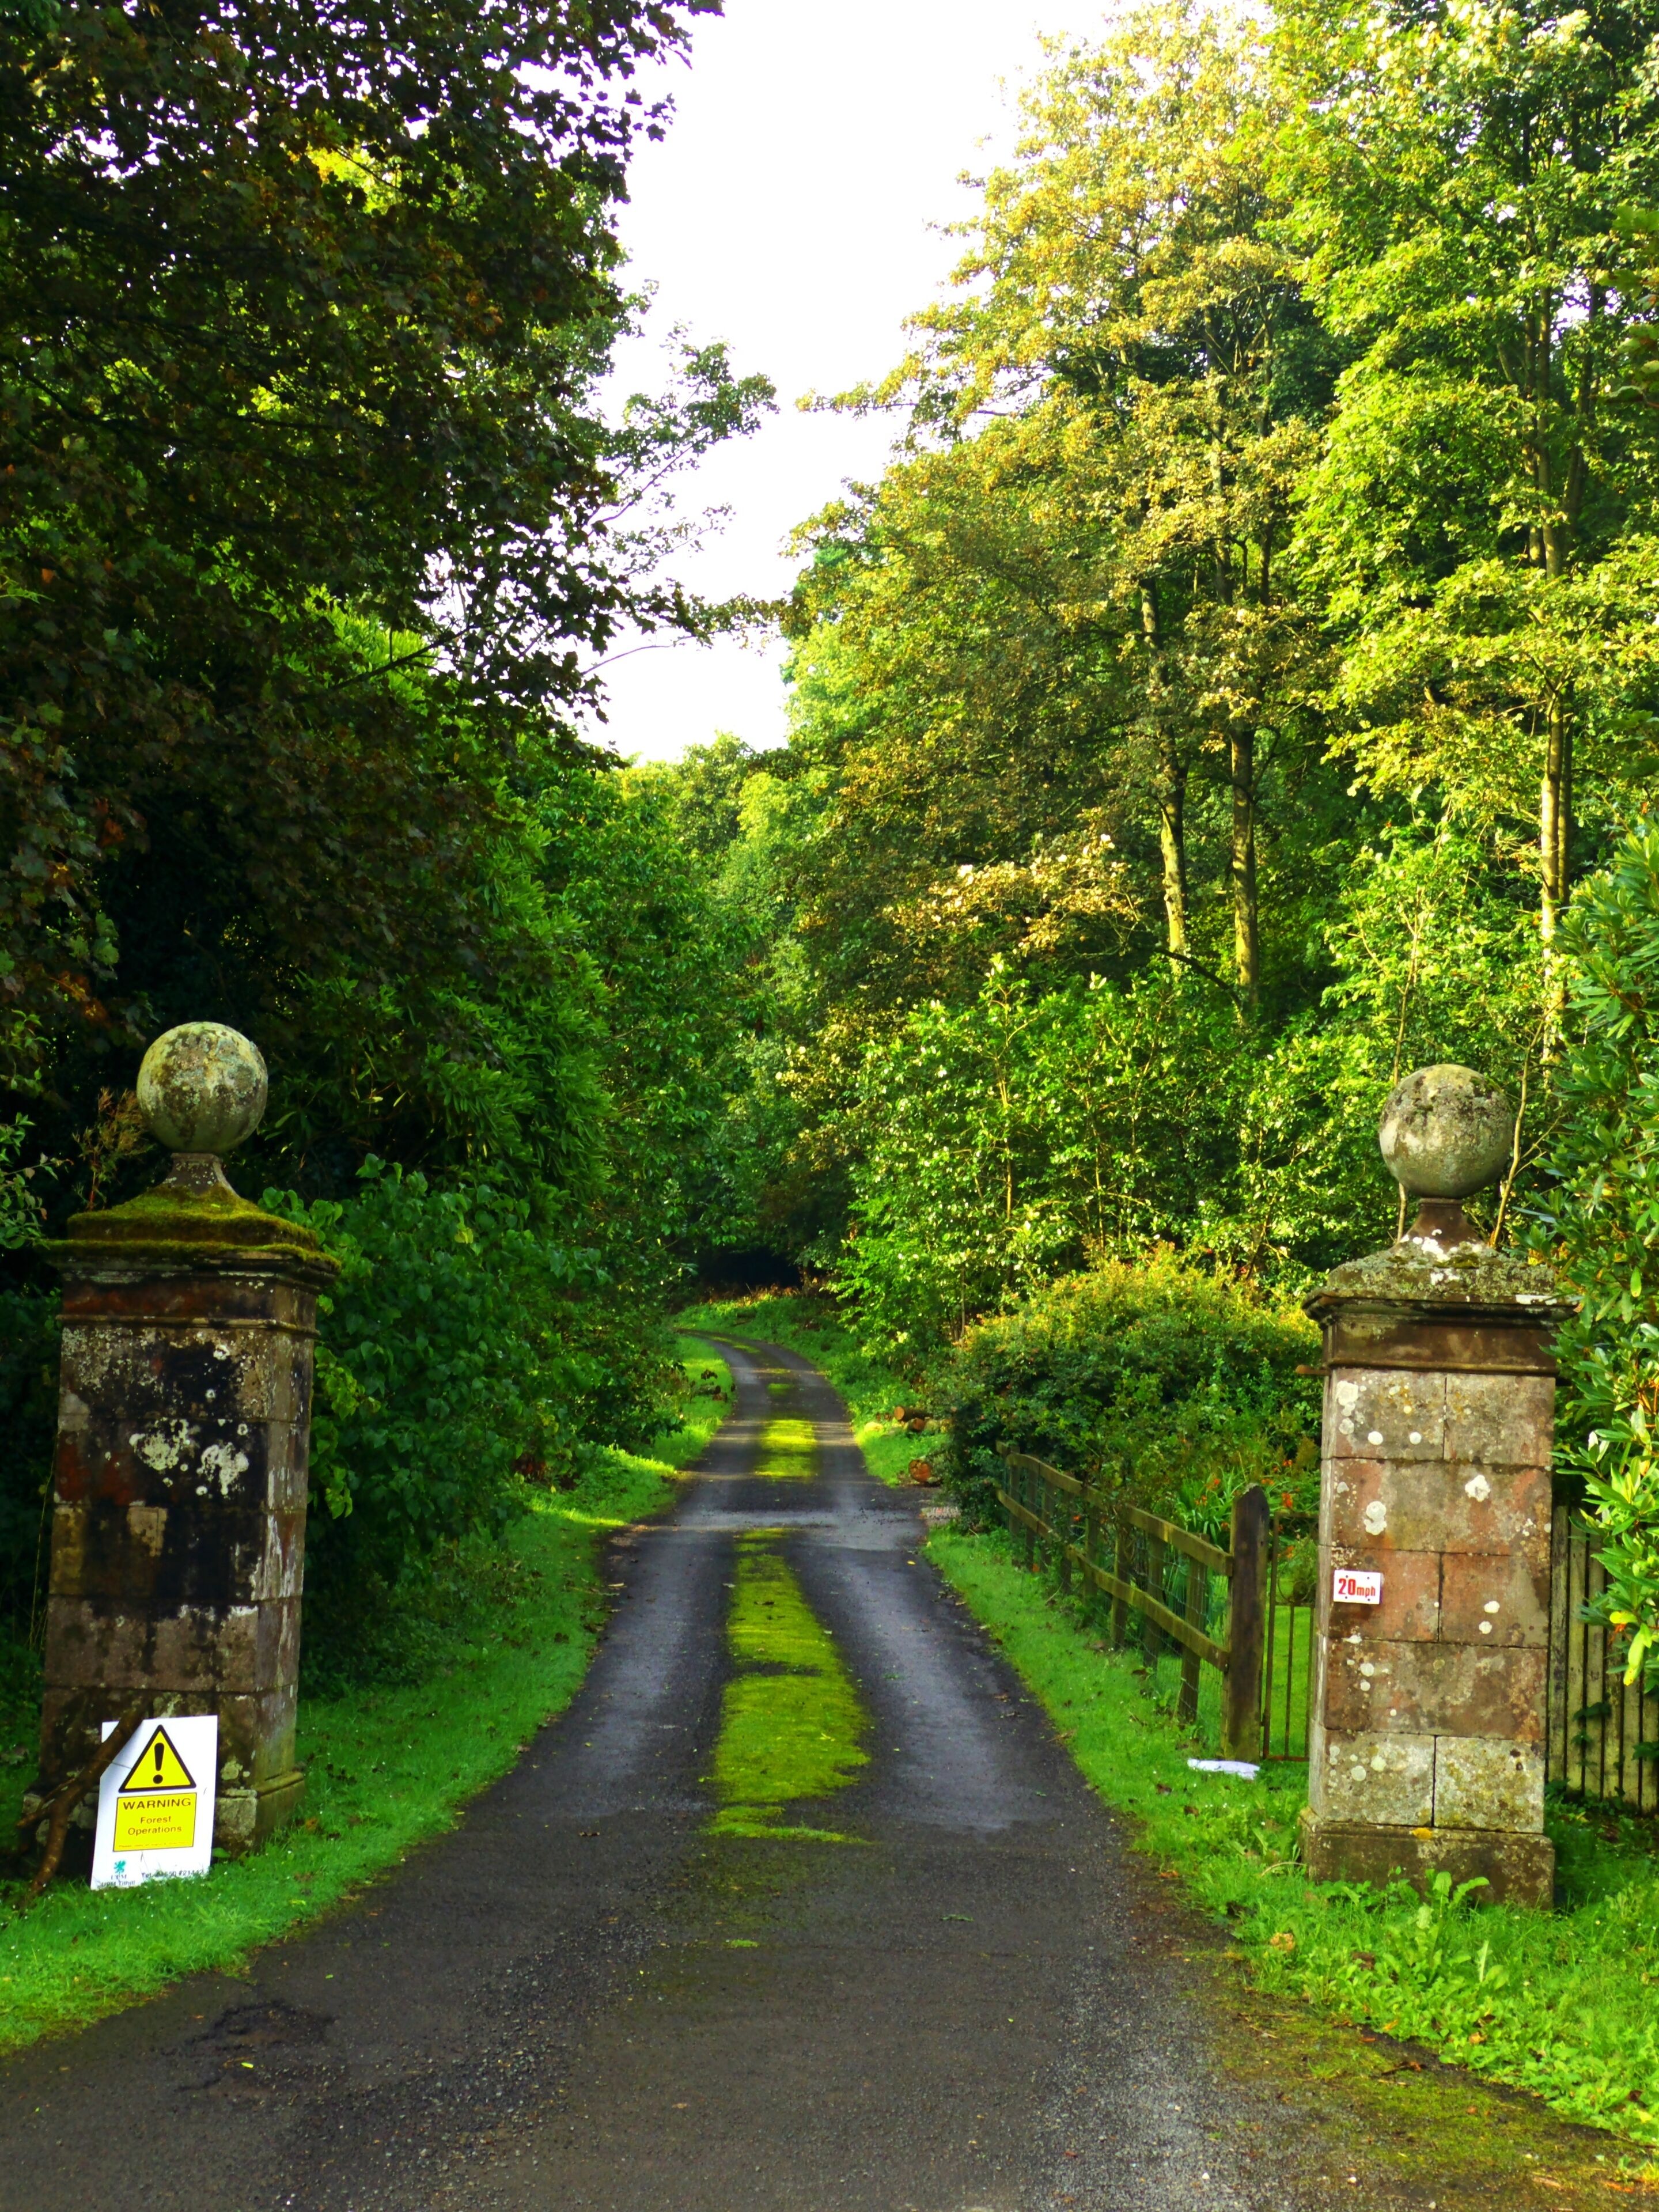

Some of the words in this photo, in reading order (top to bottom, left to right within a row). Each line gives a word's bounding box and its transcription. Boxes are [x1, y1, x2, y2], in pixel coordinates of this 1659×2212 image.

[1338, 1578, 1376, 1597] 20mph
[123, 1798, 191, 1810] WARNING
[141, 1816, 171, 1824] Forest
[128, 1826, 182, 1836] Operations
